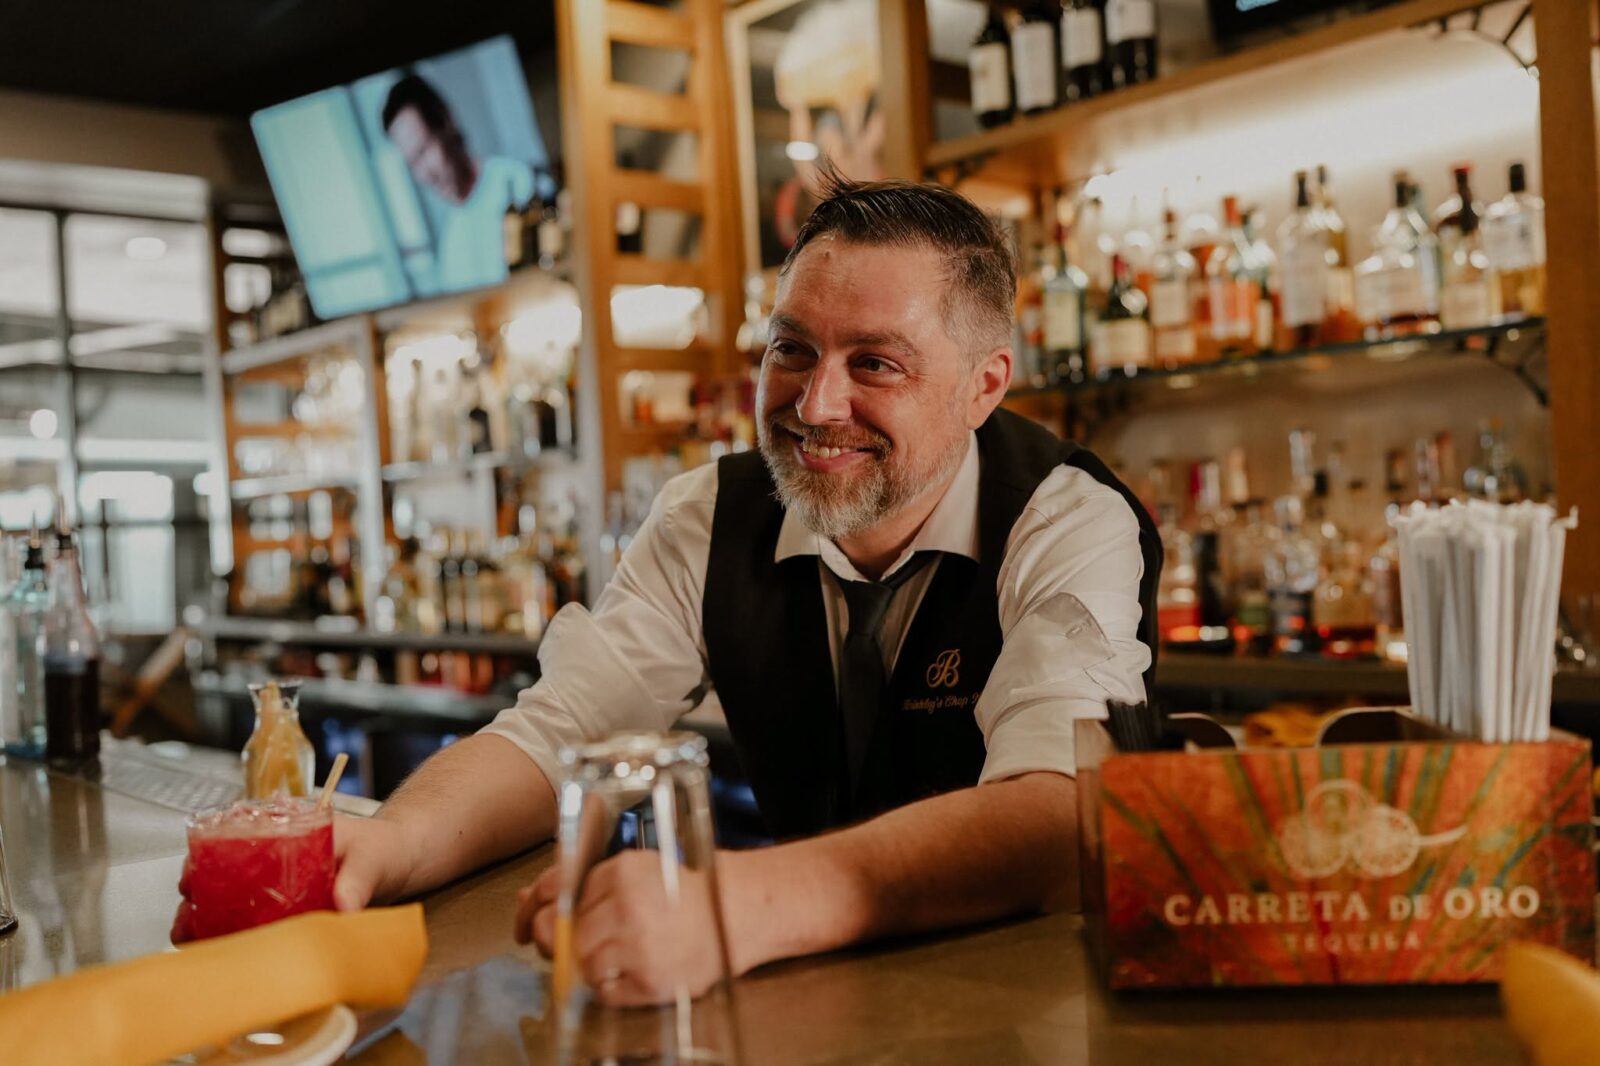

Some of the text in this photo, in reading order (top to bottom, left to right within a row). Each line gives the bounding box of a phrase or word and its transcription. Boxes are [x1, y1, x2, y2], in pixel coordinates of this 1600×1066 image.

[926, 648, 961, 688] B
[1163, 885, 1541, 925] CARRETA DE ORO
[1285, 931, 1422, 954] TEQUILA
